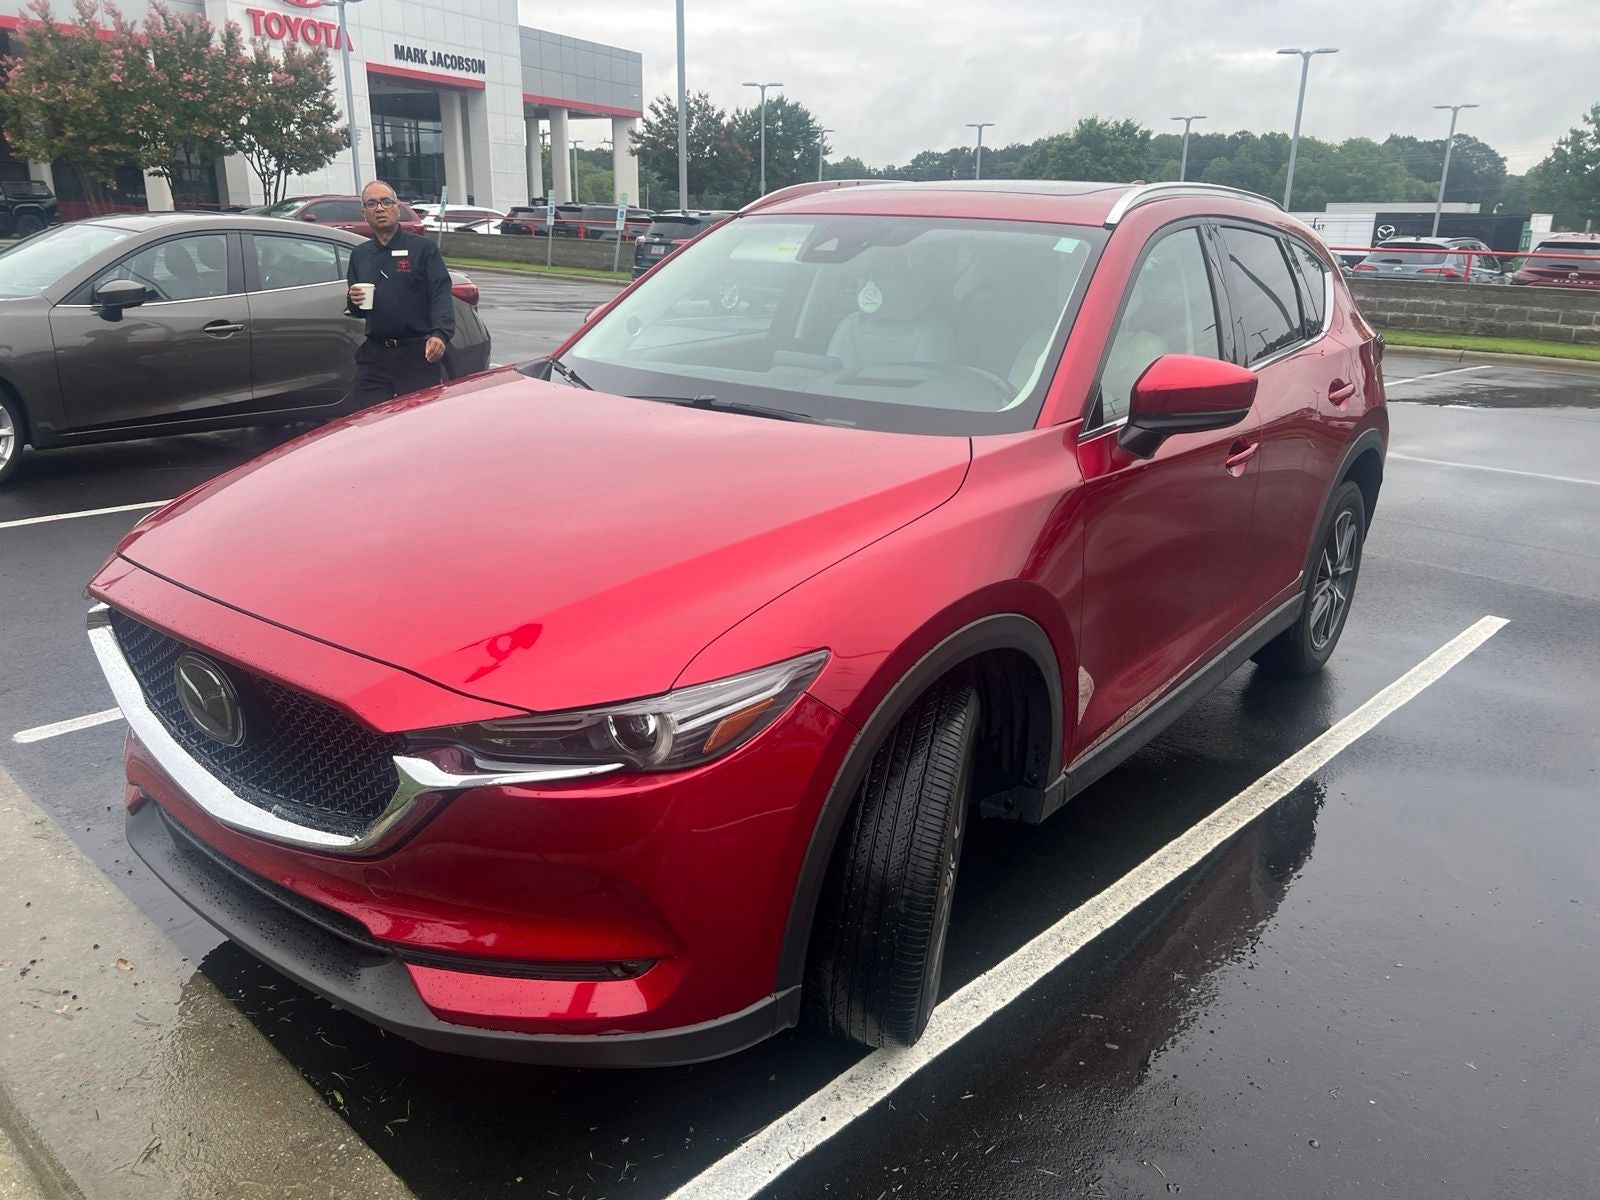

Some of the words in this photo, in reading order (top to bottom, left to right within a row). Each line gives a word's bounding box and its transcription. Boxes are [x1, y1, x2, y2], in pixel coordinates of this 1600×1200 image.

[246, 8, 353, 51] TOYOTA
[394, 43, 428, 66] MARK
[429, 51, 486, 75] JACOBSON
